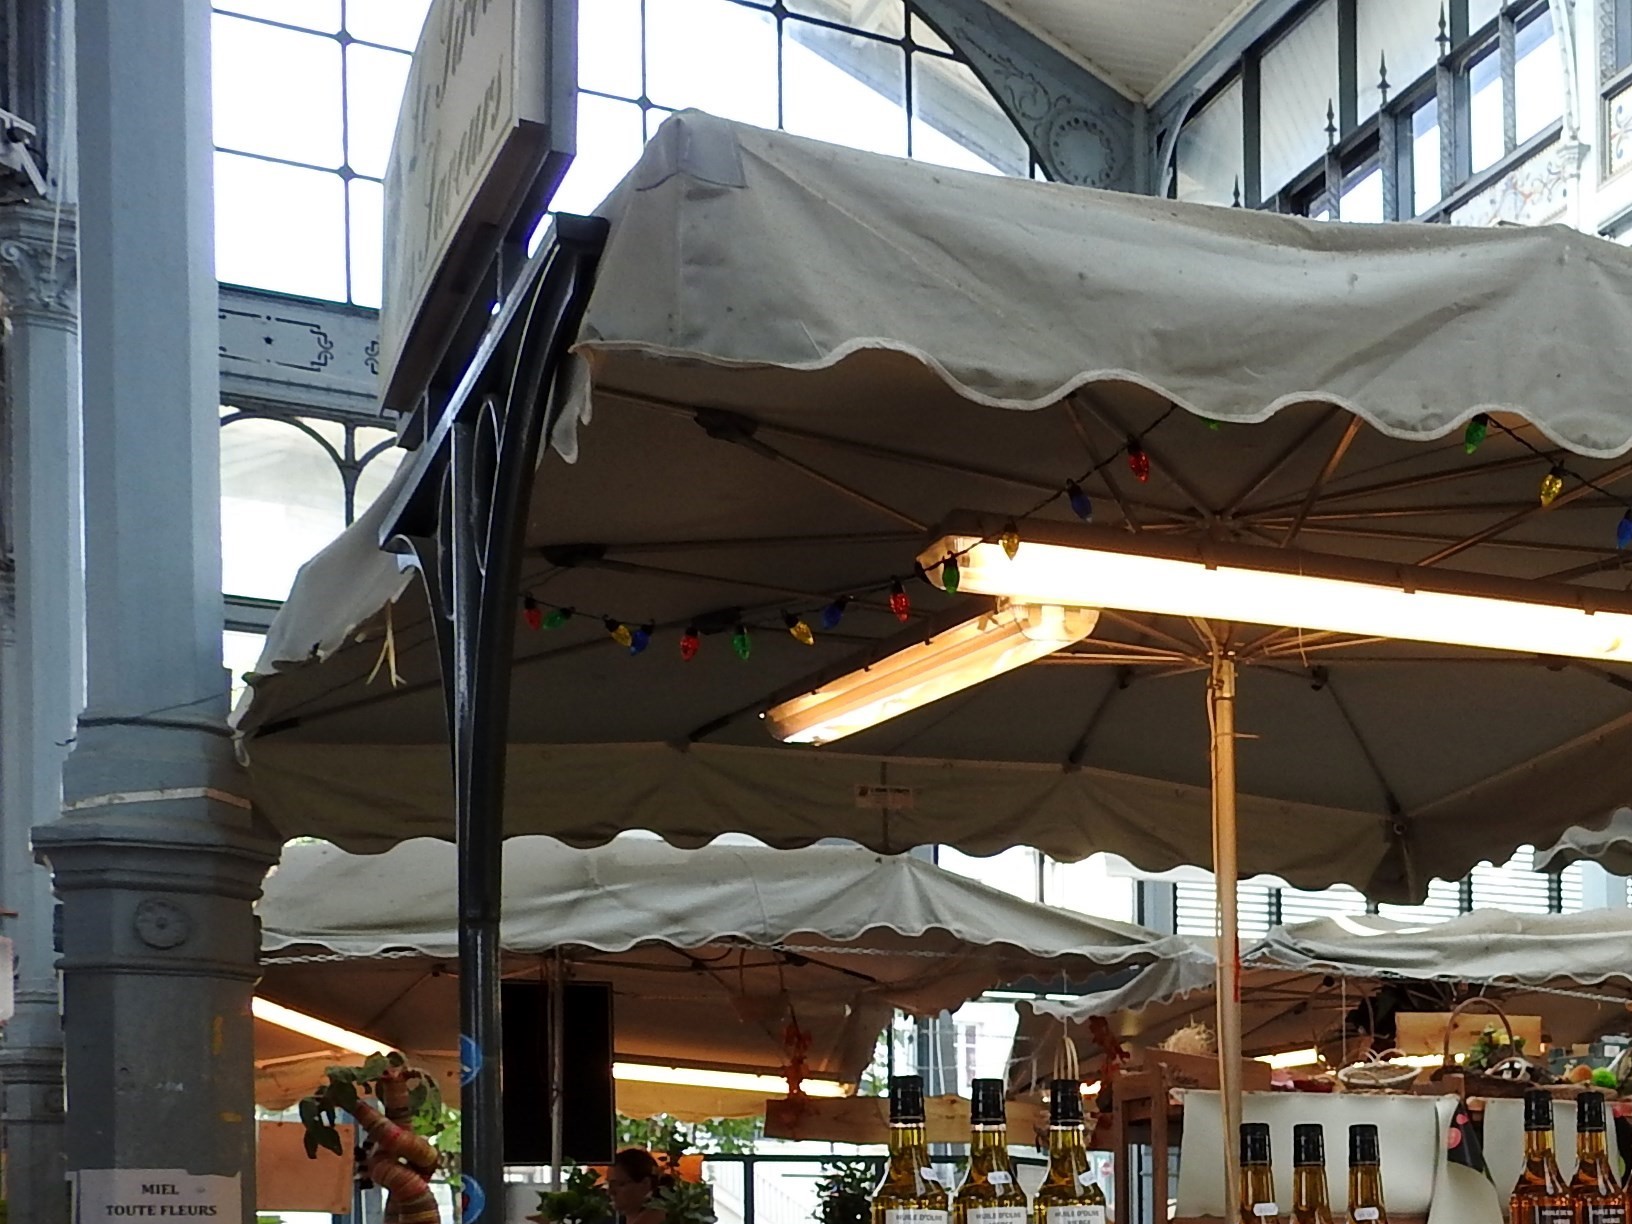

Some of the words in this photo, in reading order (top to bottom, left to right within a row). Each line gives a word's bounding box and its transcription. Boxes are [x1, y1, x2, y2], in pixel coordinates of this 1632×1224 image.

[141, 1184, 180, 1195] MIEL
[106, 1205, 157, 1216] TOUTE
[160, 1205, 217, 1216] FLEURS
